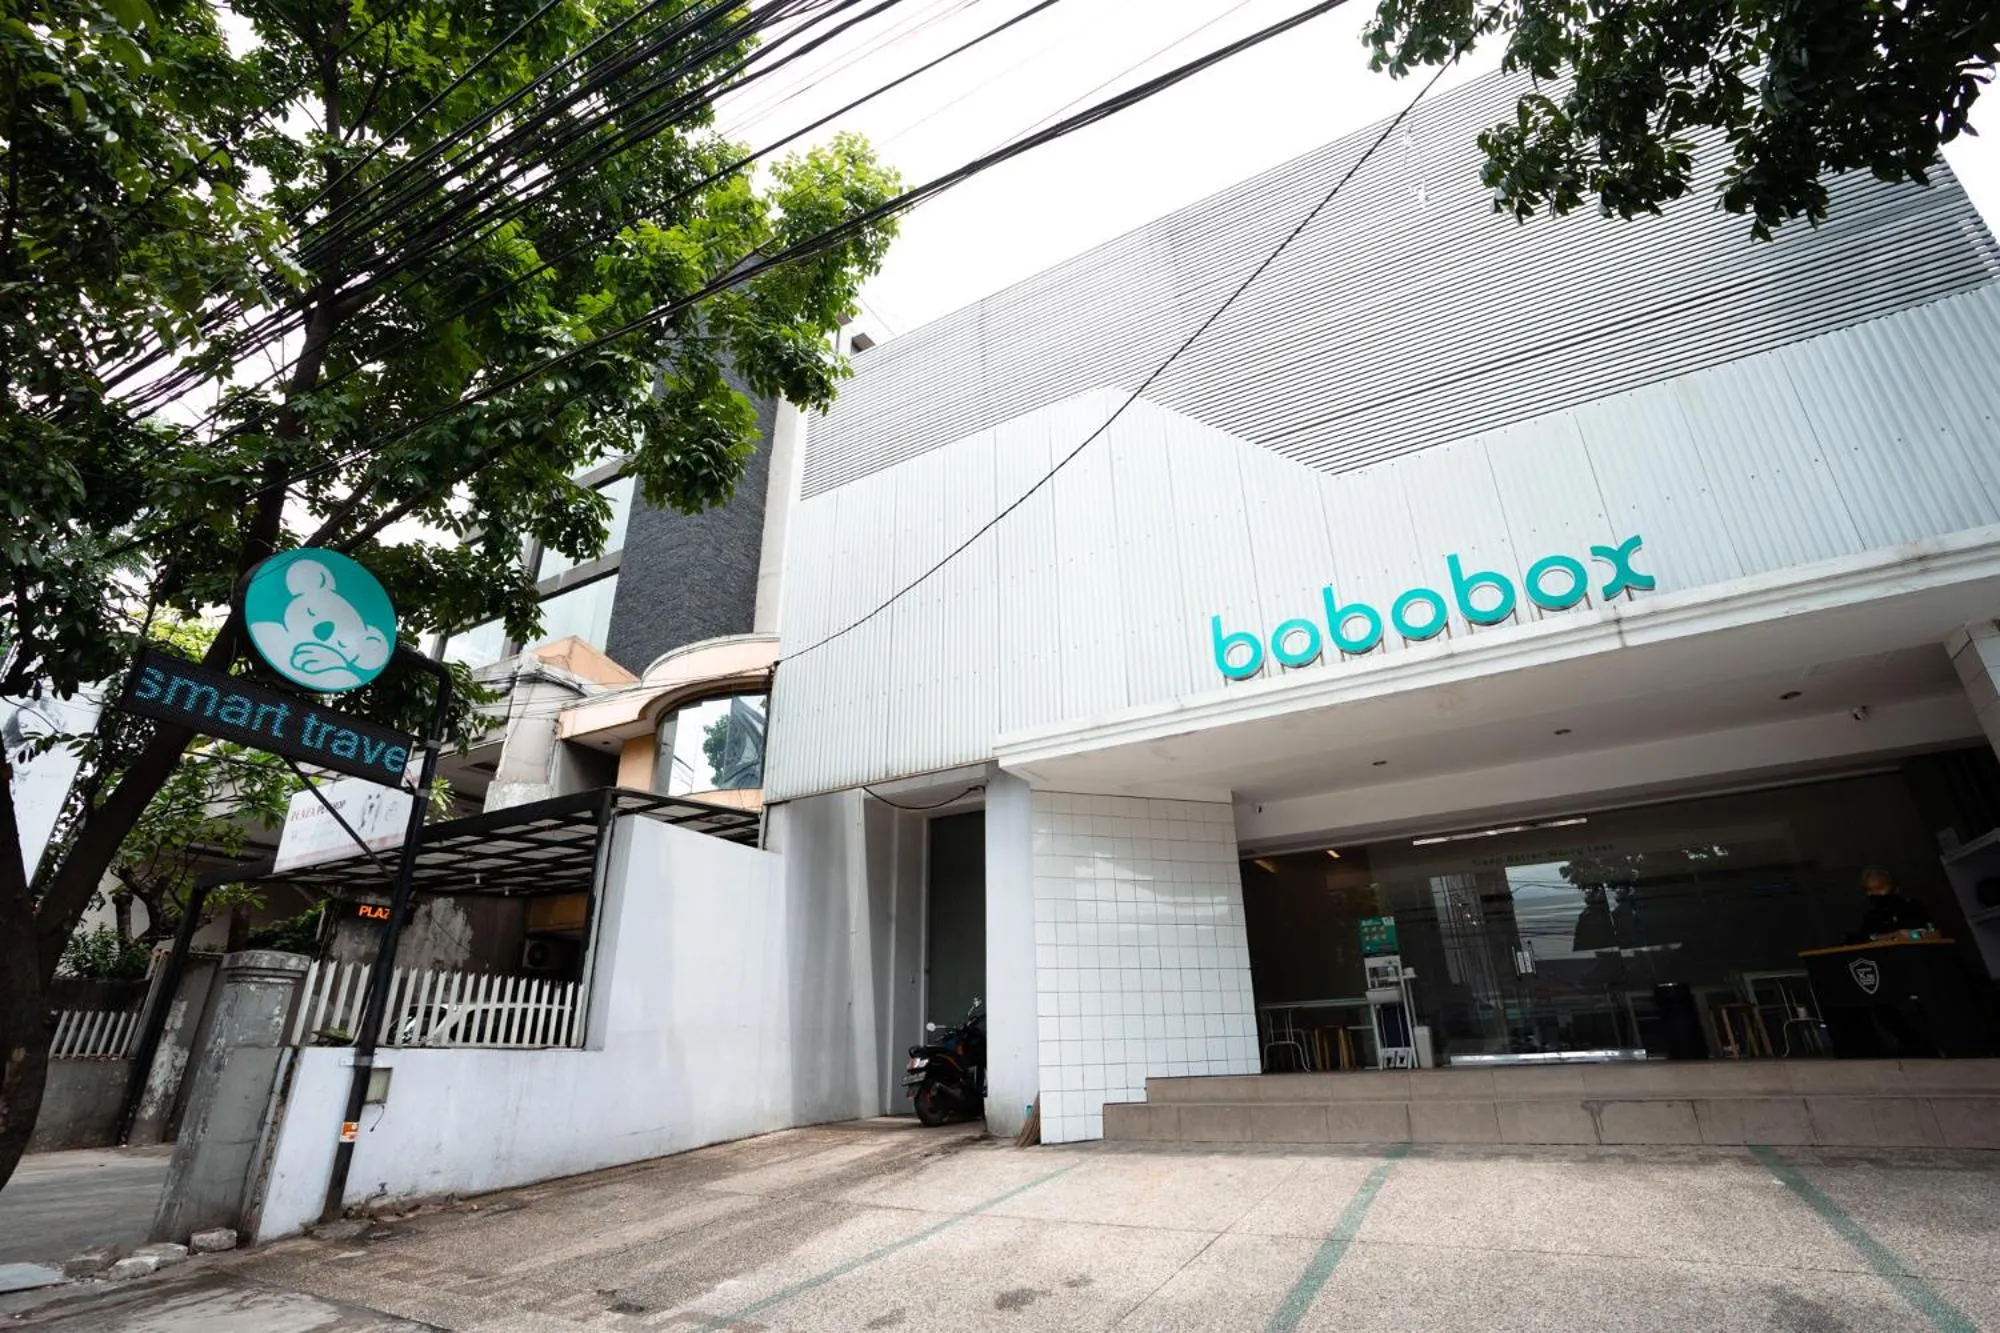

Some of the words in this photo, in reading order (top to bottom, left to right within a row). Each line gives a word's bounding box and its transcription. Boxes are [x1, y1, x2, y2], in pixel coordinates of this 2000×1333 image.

[1211, 534, 1655, 681] bobobox
[135, 667, 289, 738] smart
[301, 712, 408, 773] trave
